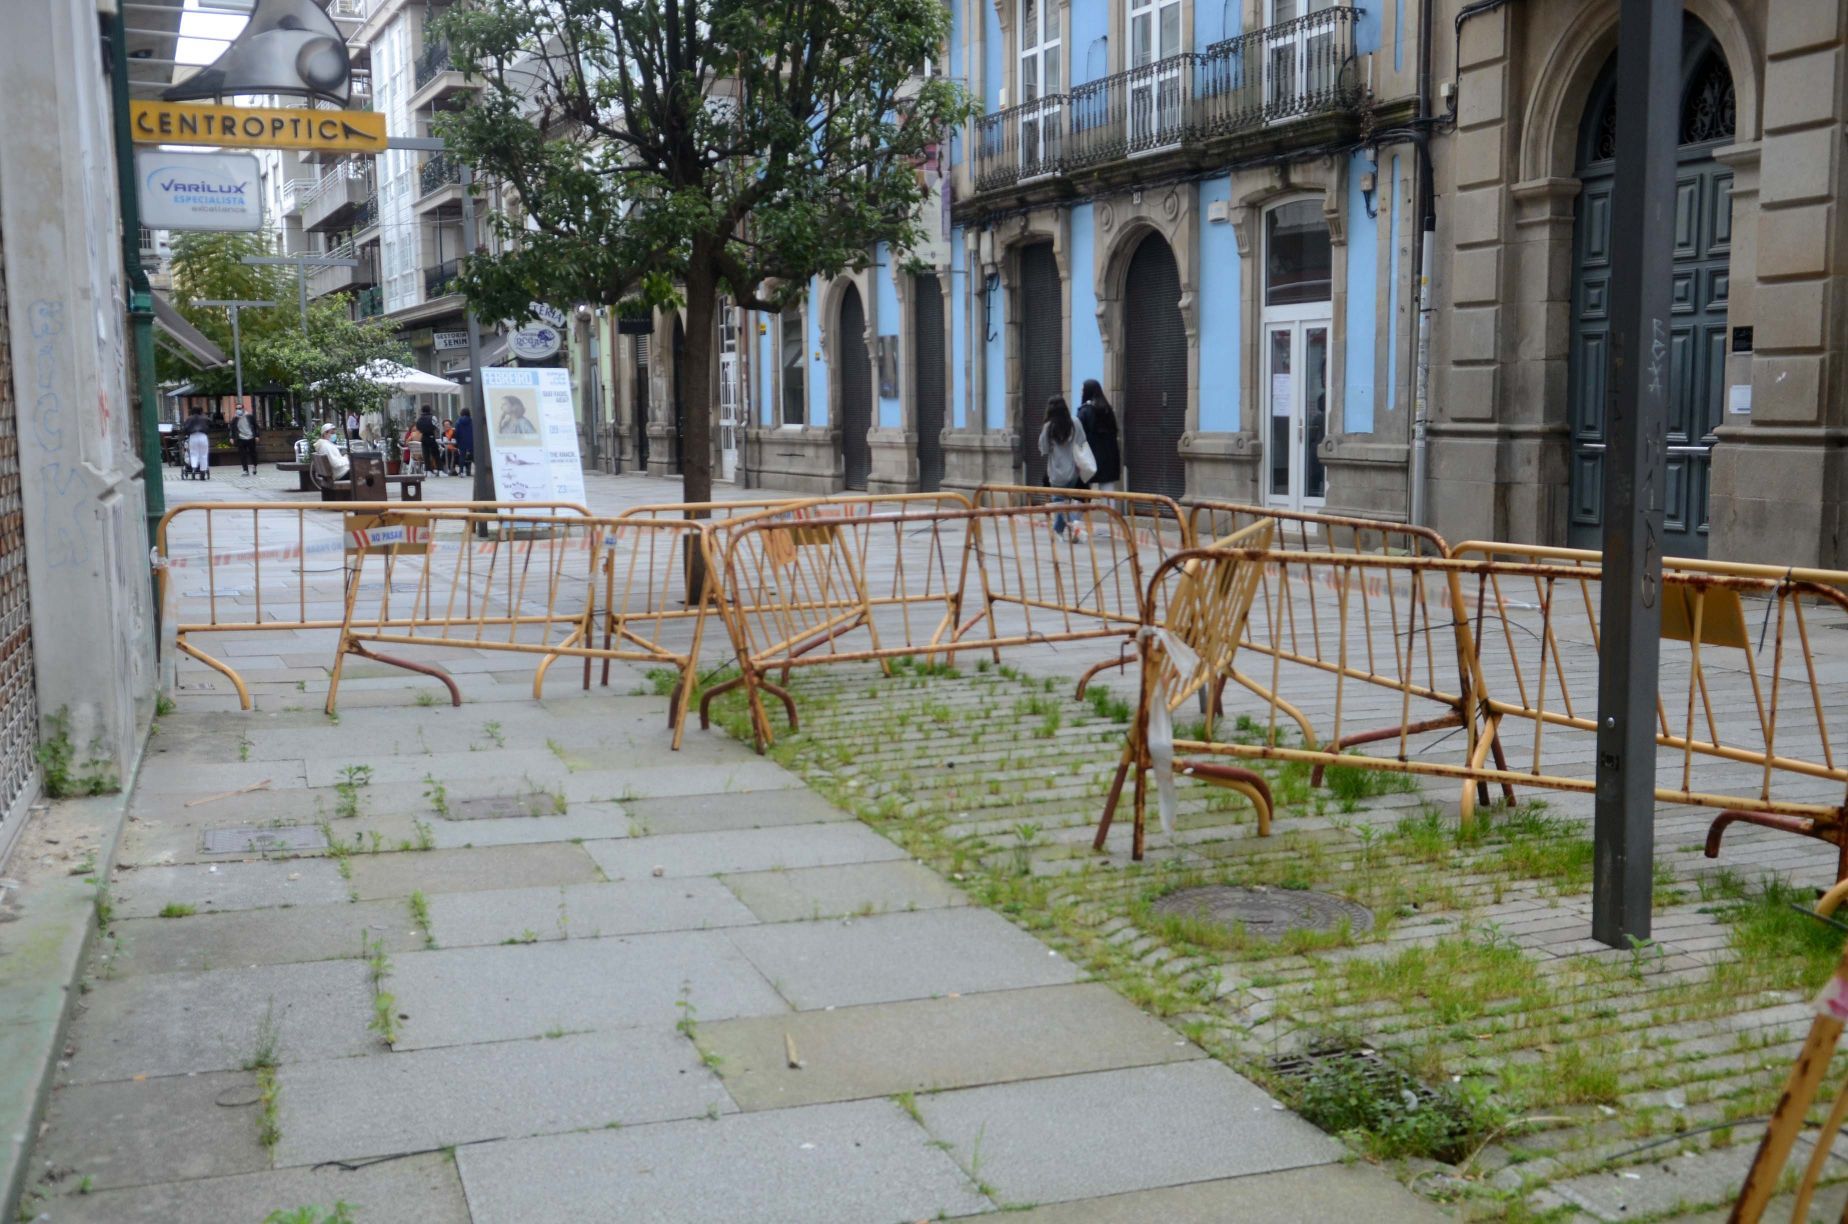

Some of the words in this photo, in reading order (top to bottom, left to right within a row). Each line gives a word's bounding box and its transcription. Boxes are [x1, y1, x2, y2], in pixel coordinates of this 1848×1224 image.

[173, 194, 245, 205] ESPECIALISTA
[435, 332, 467, 340] GESTORIA
[371, 532, 380, 542] NO
